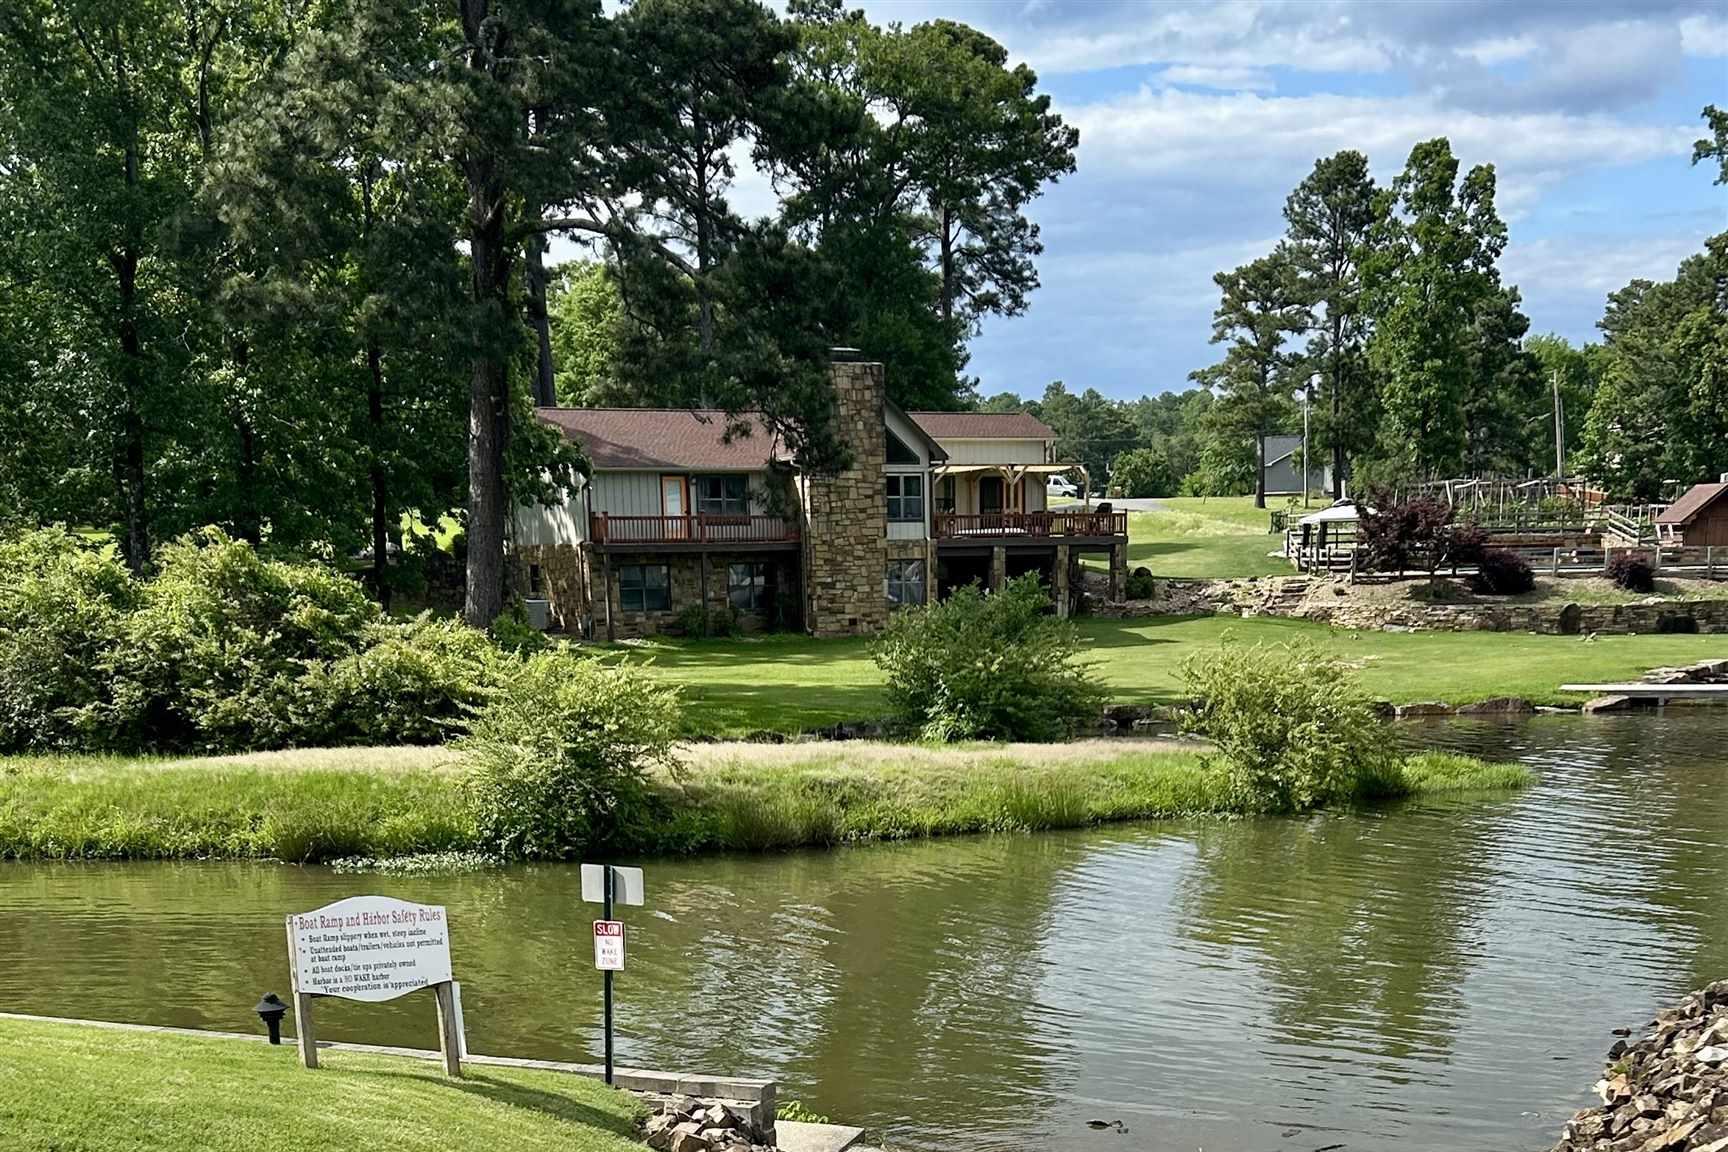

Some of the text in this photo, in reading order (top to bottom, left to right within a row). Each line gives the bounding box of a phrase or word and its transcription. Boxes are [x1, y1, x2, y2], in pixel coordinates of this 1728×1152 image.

[299, 908, 441, 931] Boat Ramp and Harbor Safety Rules
[597, 924, 619, 935] SLOW
[323, 934, 339, 943] Ramp
[354, 973, 370, 982] WAKE
[342, 983, 381, 993] cooperation
[391, 978, 428, 990] appreciated
